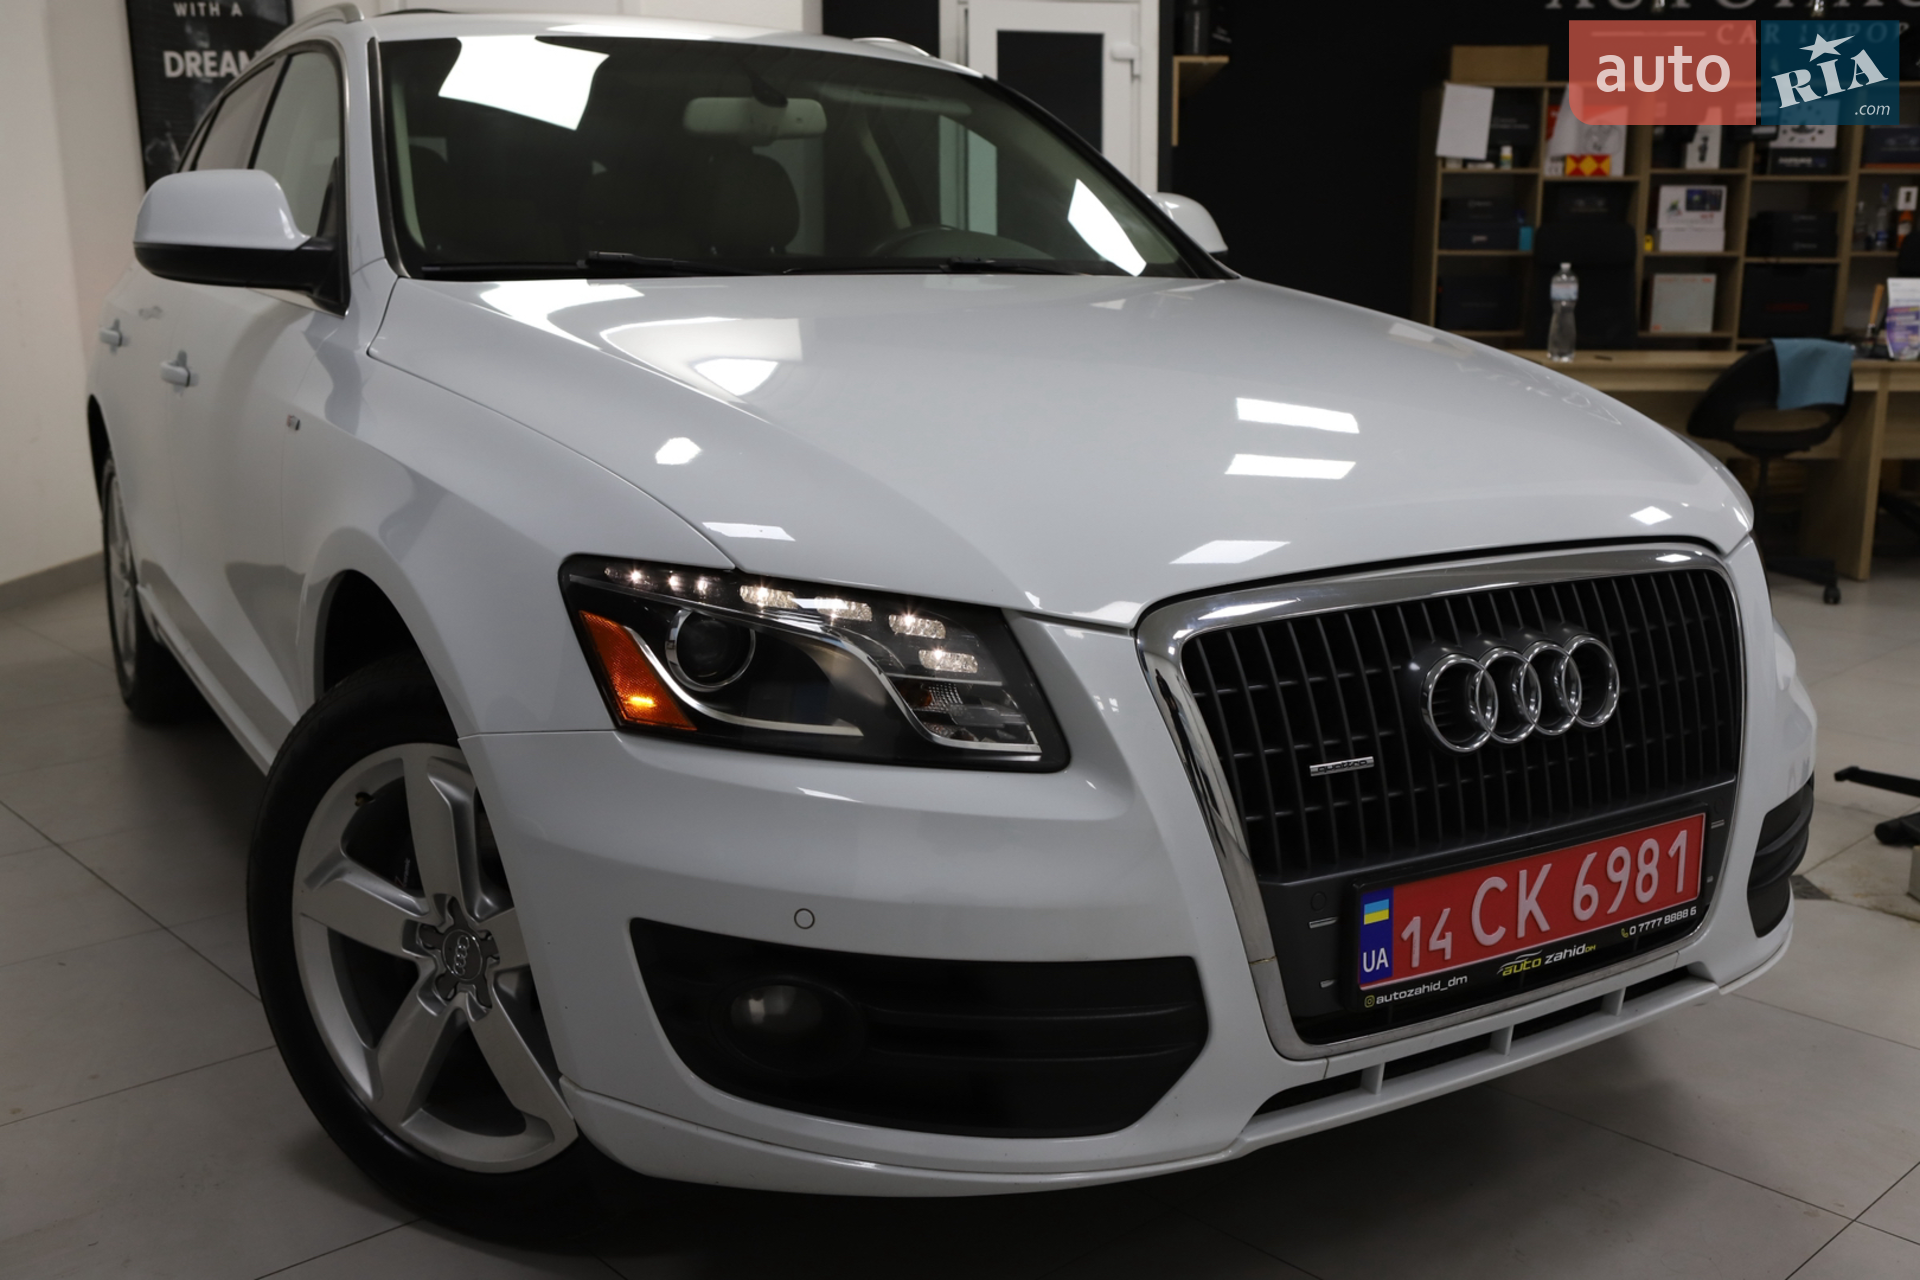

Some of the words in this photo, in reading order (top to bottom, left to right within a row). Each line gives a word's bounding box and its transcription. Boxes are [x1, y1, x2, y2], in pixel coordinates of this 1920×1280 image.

[173, 2, 221, 17] WITH
[230, 2, 243, 17] A
[1317, 759, 1368, 773] quattro
[1400, 907, 1453, 968] 14
[1471, 863, 1552, 946] CK
[1572, 830, 1688, 922] 6981
[1638, 917, 1662, 932] 7777
[1664, 908, 1688, 924] 8888
[1362, 947, 1389, 973] UA
[1501, 957, 1542, 977] auto
[1375, 975, 1468, 1005] autozahid_dm
